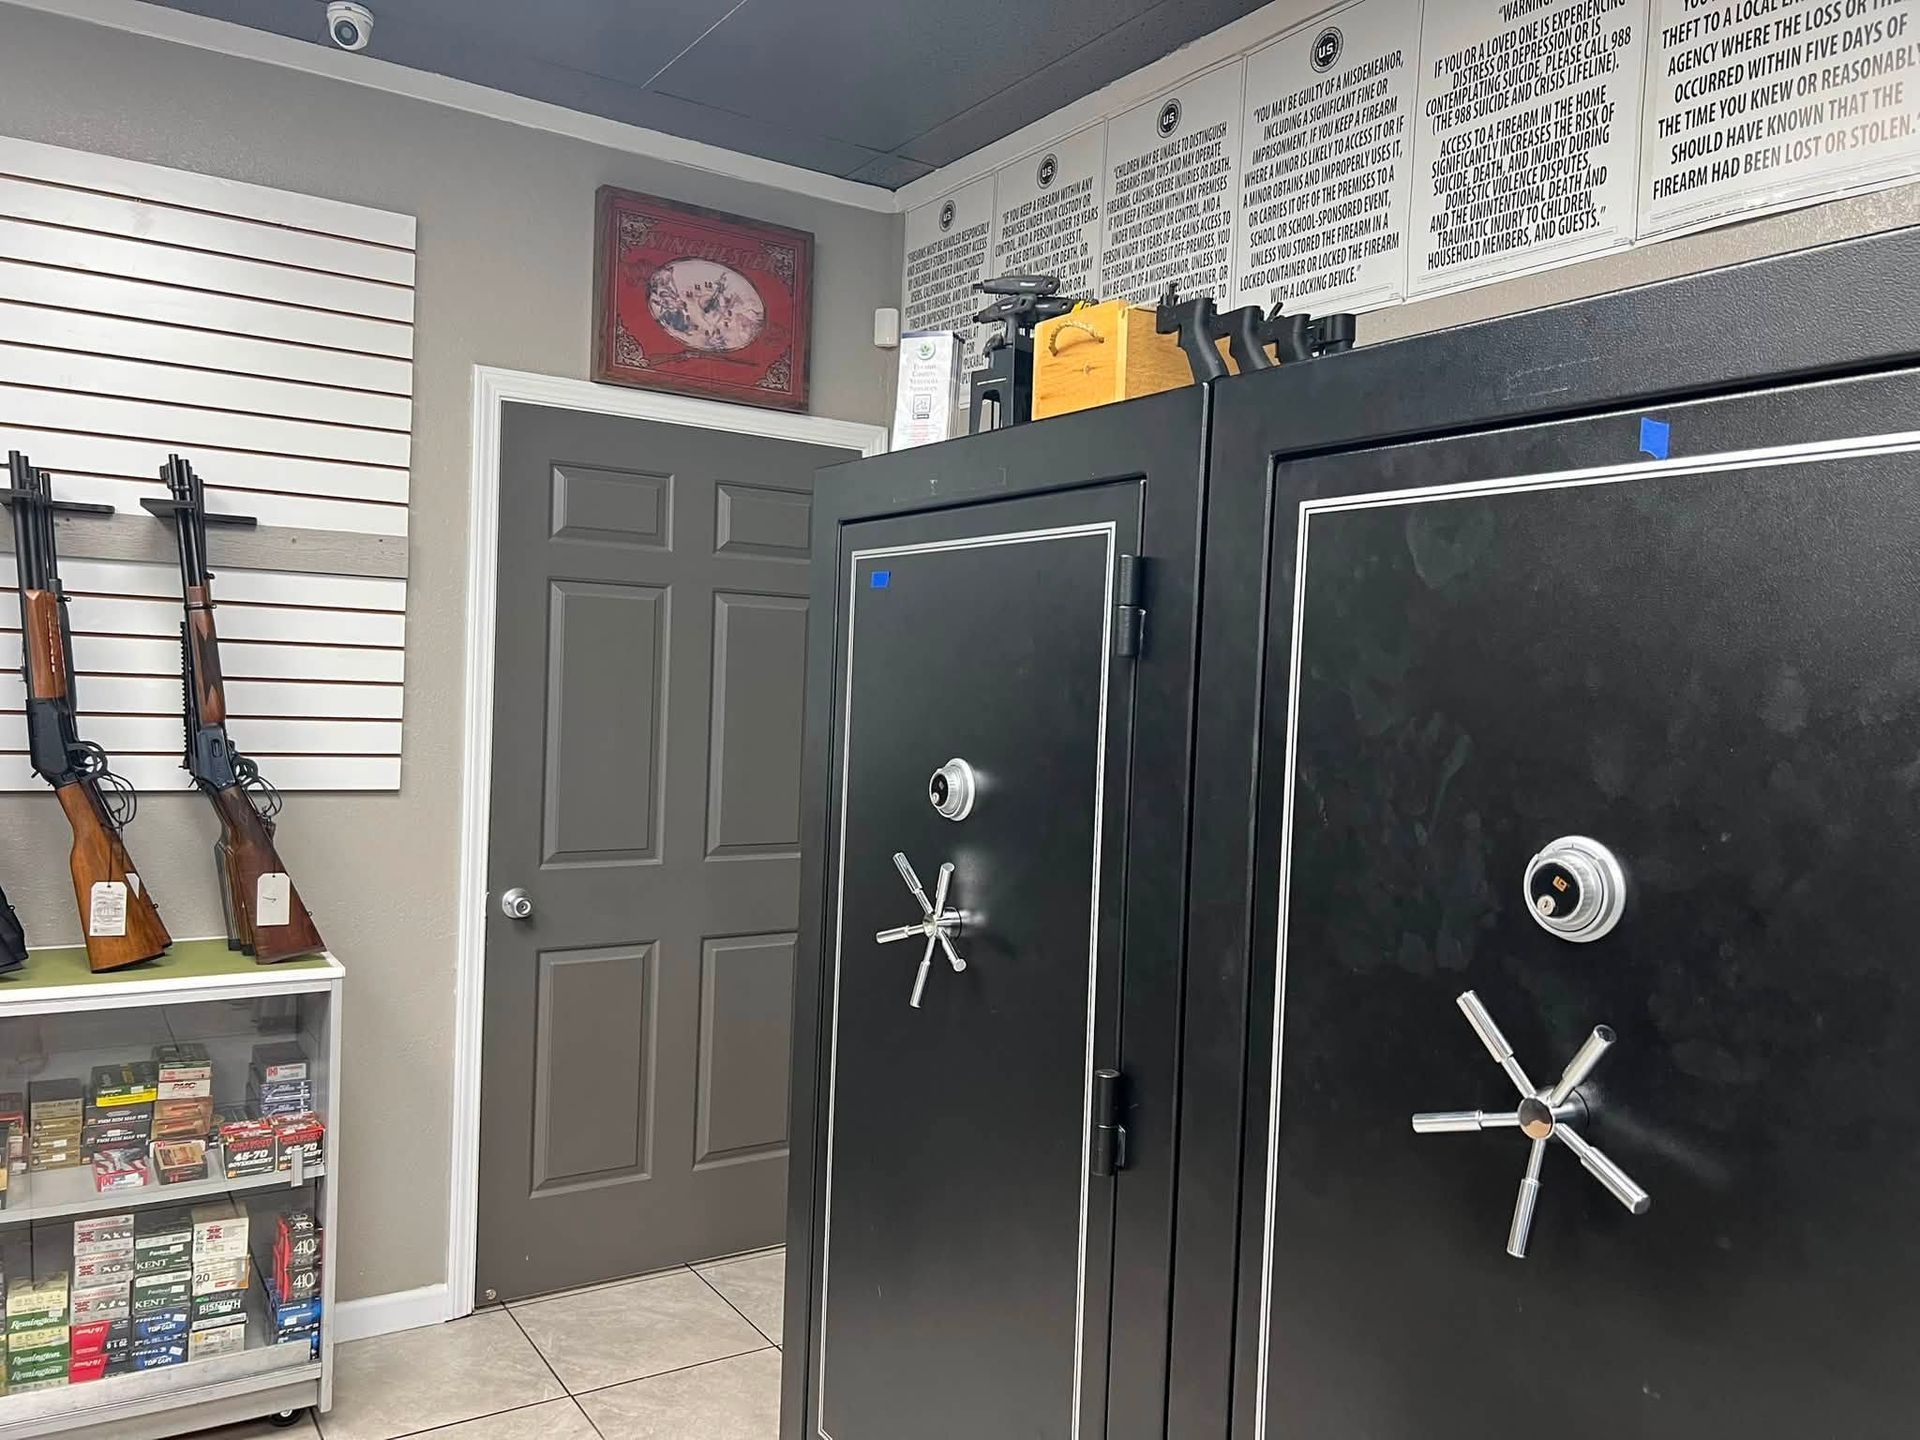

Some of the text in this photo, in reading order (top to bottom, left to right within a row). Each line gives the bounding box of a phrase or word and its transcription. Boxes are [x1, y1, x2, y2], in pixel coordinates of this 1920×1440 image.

[1434, 58, 1443, 78] IF
[1444, 50, 1462, 74] YOU
[1463, 45, 1476, 66] OR
[1477, 42, 1484, 61] A
[1486, 30, 1516, 58] LOVED
[1518, 20, 1538, 45] ONE
[1540, 16, 1549, 37] IS
[1452, 16, 1601, 89] DISTRESS OR DEPRESSION OR IS
[1662, 16, 1701, 49] THEFT
[1703, 10, 1720, 34] TO
[1722, 6, 1731, 28] A
[1667, 40, 1718, 77] AGENCY
[1721, 23, 1770, 58] WHERE
[1774, 13, 1801, 41] THE
[1805, 0, 1842, 31] LOSS
[1674, 12, 1908, 103] OCCURRED WITHIN FIVE DAYS OF
[1270, 96, 1287, 118] MAY
[1287, 92, 1297, 111] BE
[1298, 80, 1324, 107] GUILTY
[1324, 76, 1335, 96] OF
[1335, 74, 1341, 92] A
[1425, 25, 1631, 117] CONTEMPLATING SUICIDE, PLEASE CALL 988
[1432, 51, 1619, 134] (THE 988 SUICIDE AND CRISIS LIFELINE).
[1309, 126, 1317, 144] IF
[1318, 119, 1333, 141] YOU
[1334, 112, 1354, 135] KEEP
[1353, 109, 1360, 127] A
[1361, 95, 1397, 124] FIREARM
[1439, 84, 1606, 158] ACCESS TO A FIREARM IN THE HOME
[1657, 113, 1681, 139] THE
[1684, 101, 1716, 130] TIME
[1719, 92, 1746, 119] YOU
[1750, 78, 1793, 110] KNEW
[1796, 72, 1817, 96] OR
[1670, 80, 1903, 165] SHOULD HAVE KNOWN THAT THE
[1431, 101, 1615, 179] SIGNIFICANTLY INCREASES THE RISK OF
[1432, 123, 1609, 196] SUICIDE, DEATH, AND INJURY DURING
[1653, 165, 1707, 200] FIREARM
[1711, 156, 1740, 183] HAD
[1743, 145, 1781, 174] BEEN
[1784, 135, 1821, 164] LOST
[1826, 129, 1846, 154] OR
[1249, 225, 1275, 248] SCHOOL
[1277, 222, 1287, 239] OR
[1288, 198, 1362, 236] SCHOOL-SPONSORED
[1250, 212, 1388, 268] UNLESS YOU STORED THE FIREARM IN A
[1427, 240, 1480, 270] HOUSEHOLD
[1481, 226, 1531, 256] MEMBERS,
[1533, 220, 1555, 242] AND
[1239, 232, 1399, 291] LOCKED CONTAINER OR LOCKED THE FIREARM
[136, 1258, 169, 1270] KENT
[293, 1239, 316, 1255] 410
[135, 1297, 168, 1309] KENT
[195, 1273, 210, 1283] 20
[292, 1272, 316, 1288] 410
